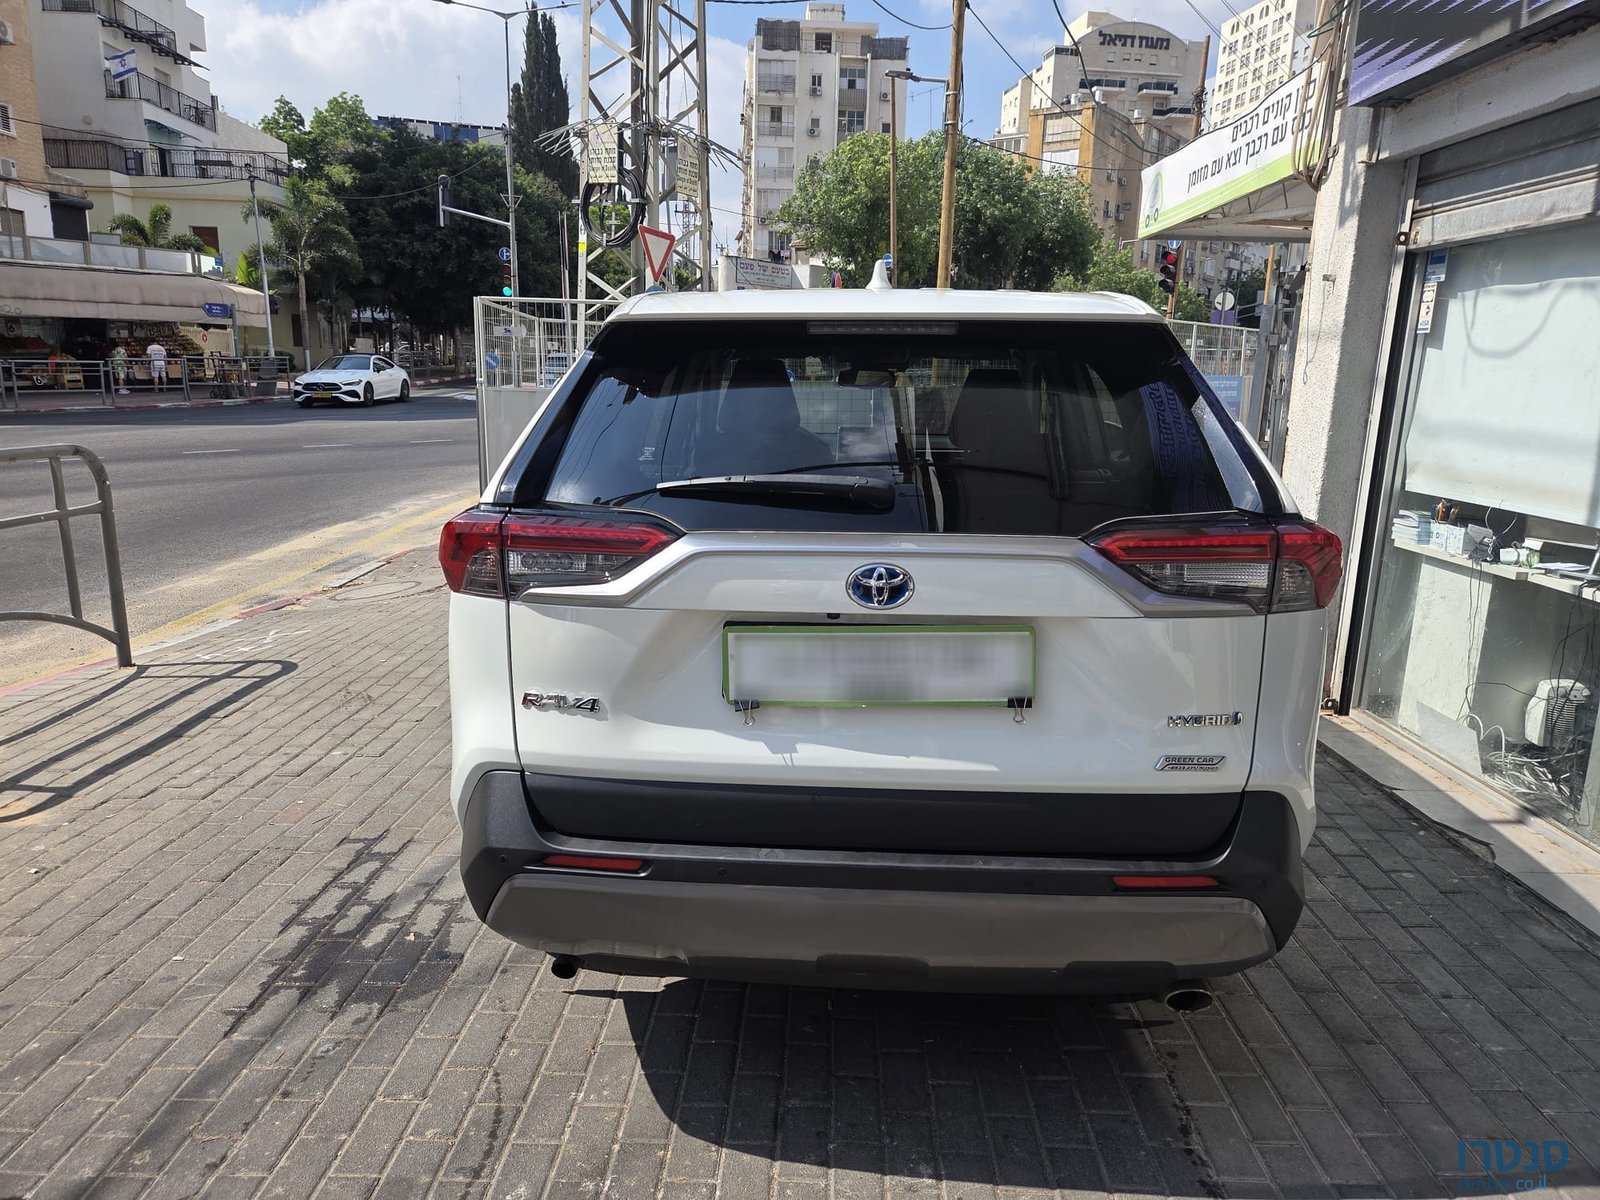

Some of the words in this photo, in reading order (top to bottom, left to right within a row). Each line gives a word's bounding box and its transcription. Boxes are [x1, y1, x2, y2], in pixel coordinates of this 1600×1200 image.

[1098, 30, 1137, 47] דניאל
[1294, 77, 1317, 115] כן
[1262, 92, 1293, 126] קונים
[1231, 112, 1260, 144] רכבים
[1271, 120, 1288, 147] עם
[1225, 146, 1243, 171] וצא
[1245, 132, 1268, 166] רכבך
[1210, 155, 1224, 178] עם
[1187, 164, 1209, 194] מזומן
[739, 261, 755, 271] פעם
[757, 262, 769, 273] של
[771, 266, 790, 276] בטעם
[521, 692, 601, 714] RAV4
[1167, 714, 1232, 728] HYBRID
